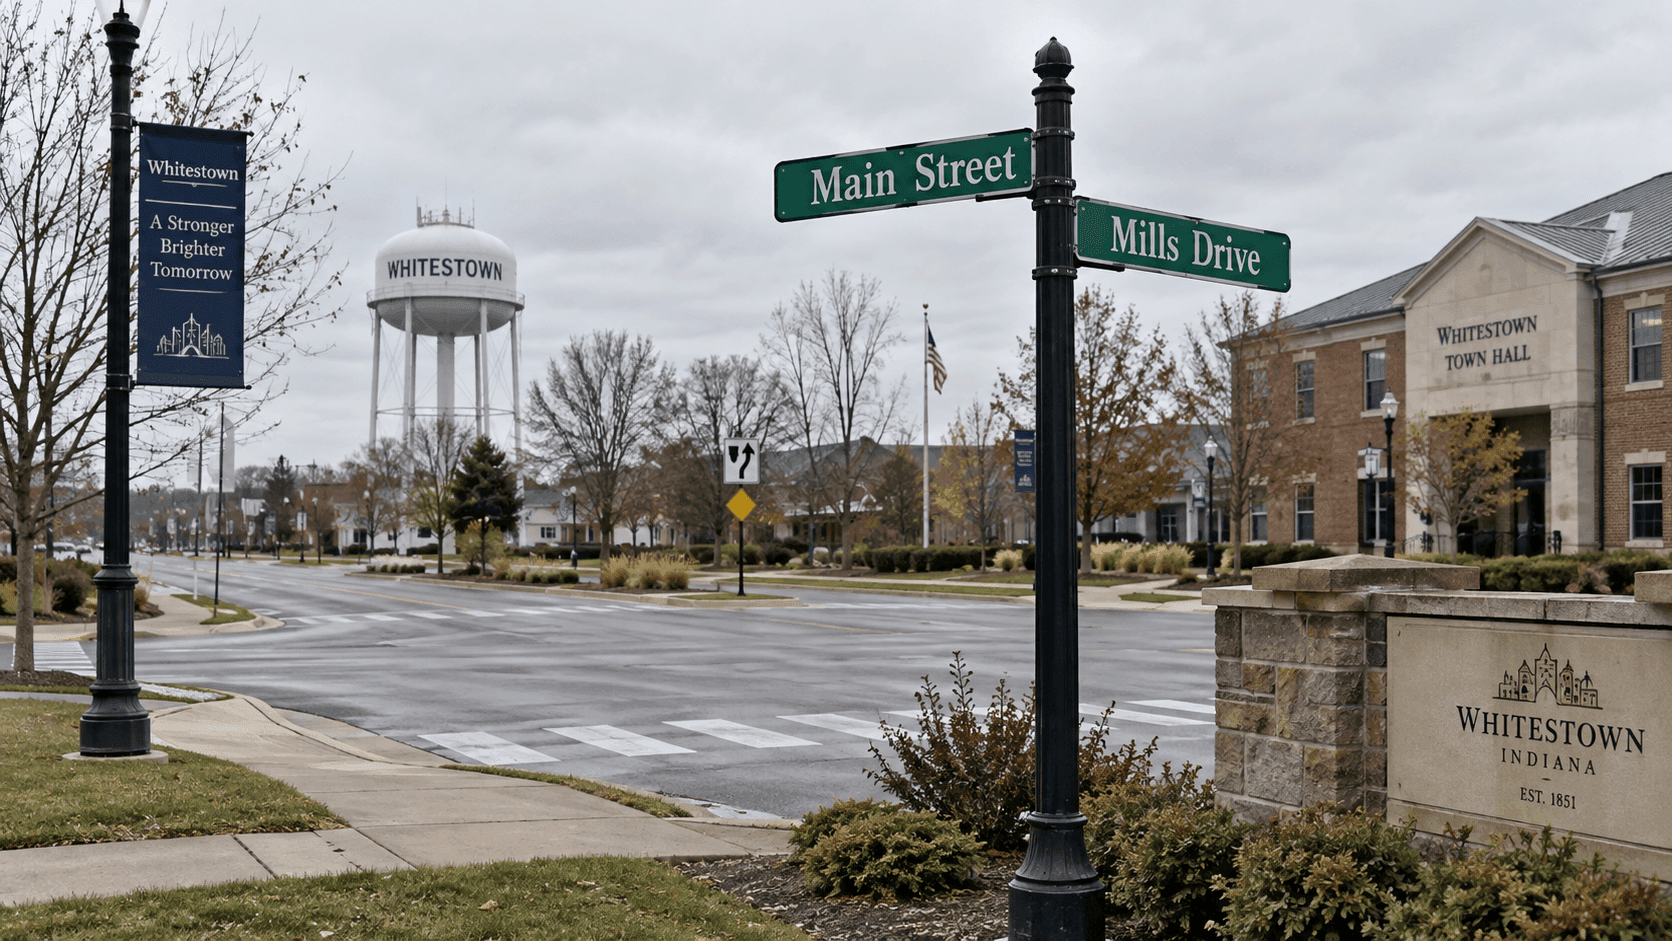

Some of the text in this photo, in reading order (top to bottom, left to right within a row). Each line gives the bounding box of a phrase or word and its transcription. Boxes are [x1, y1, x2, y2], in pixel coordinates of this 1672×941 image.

[147, 159, 239, 181] Whitestown
[811, 146, 1017, 205] Main Street
[150, 214, 235, 236] A Stronger
[160, 238, 226, 258] Brighter
[1110, 215, 1261, 276] Mills Drive
[150, 261, 233, 281] Tomorrow
[387, 258, 503, 281] WHITESTOWN
[1437, 315, 1538, 346] WHITESTOWN
[1445, 344, 1531, 371] TOWN HALL
[1456, 705, 1646, 754] WHITESTOWN
[1501, 748, 1597, 776] INDIANA
[1520, 787, 1577, 810] EST. 1851
